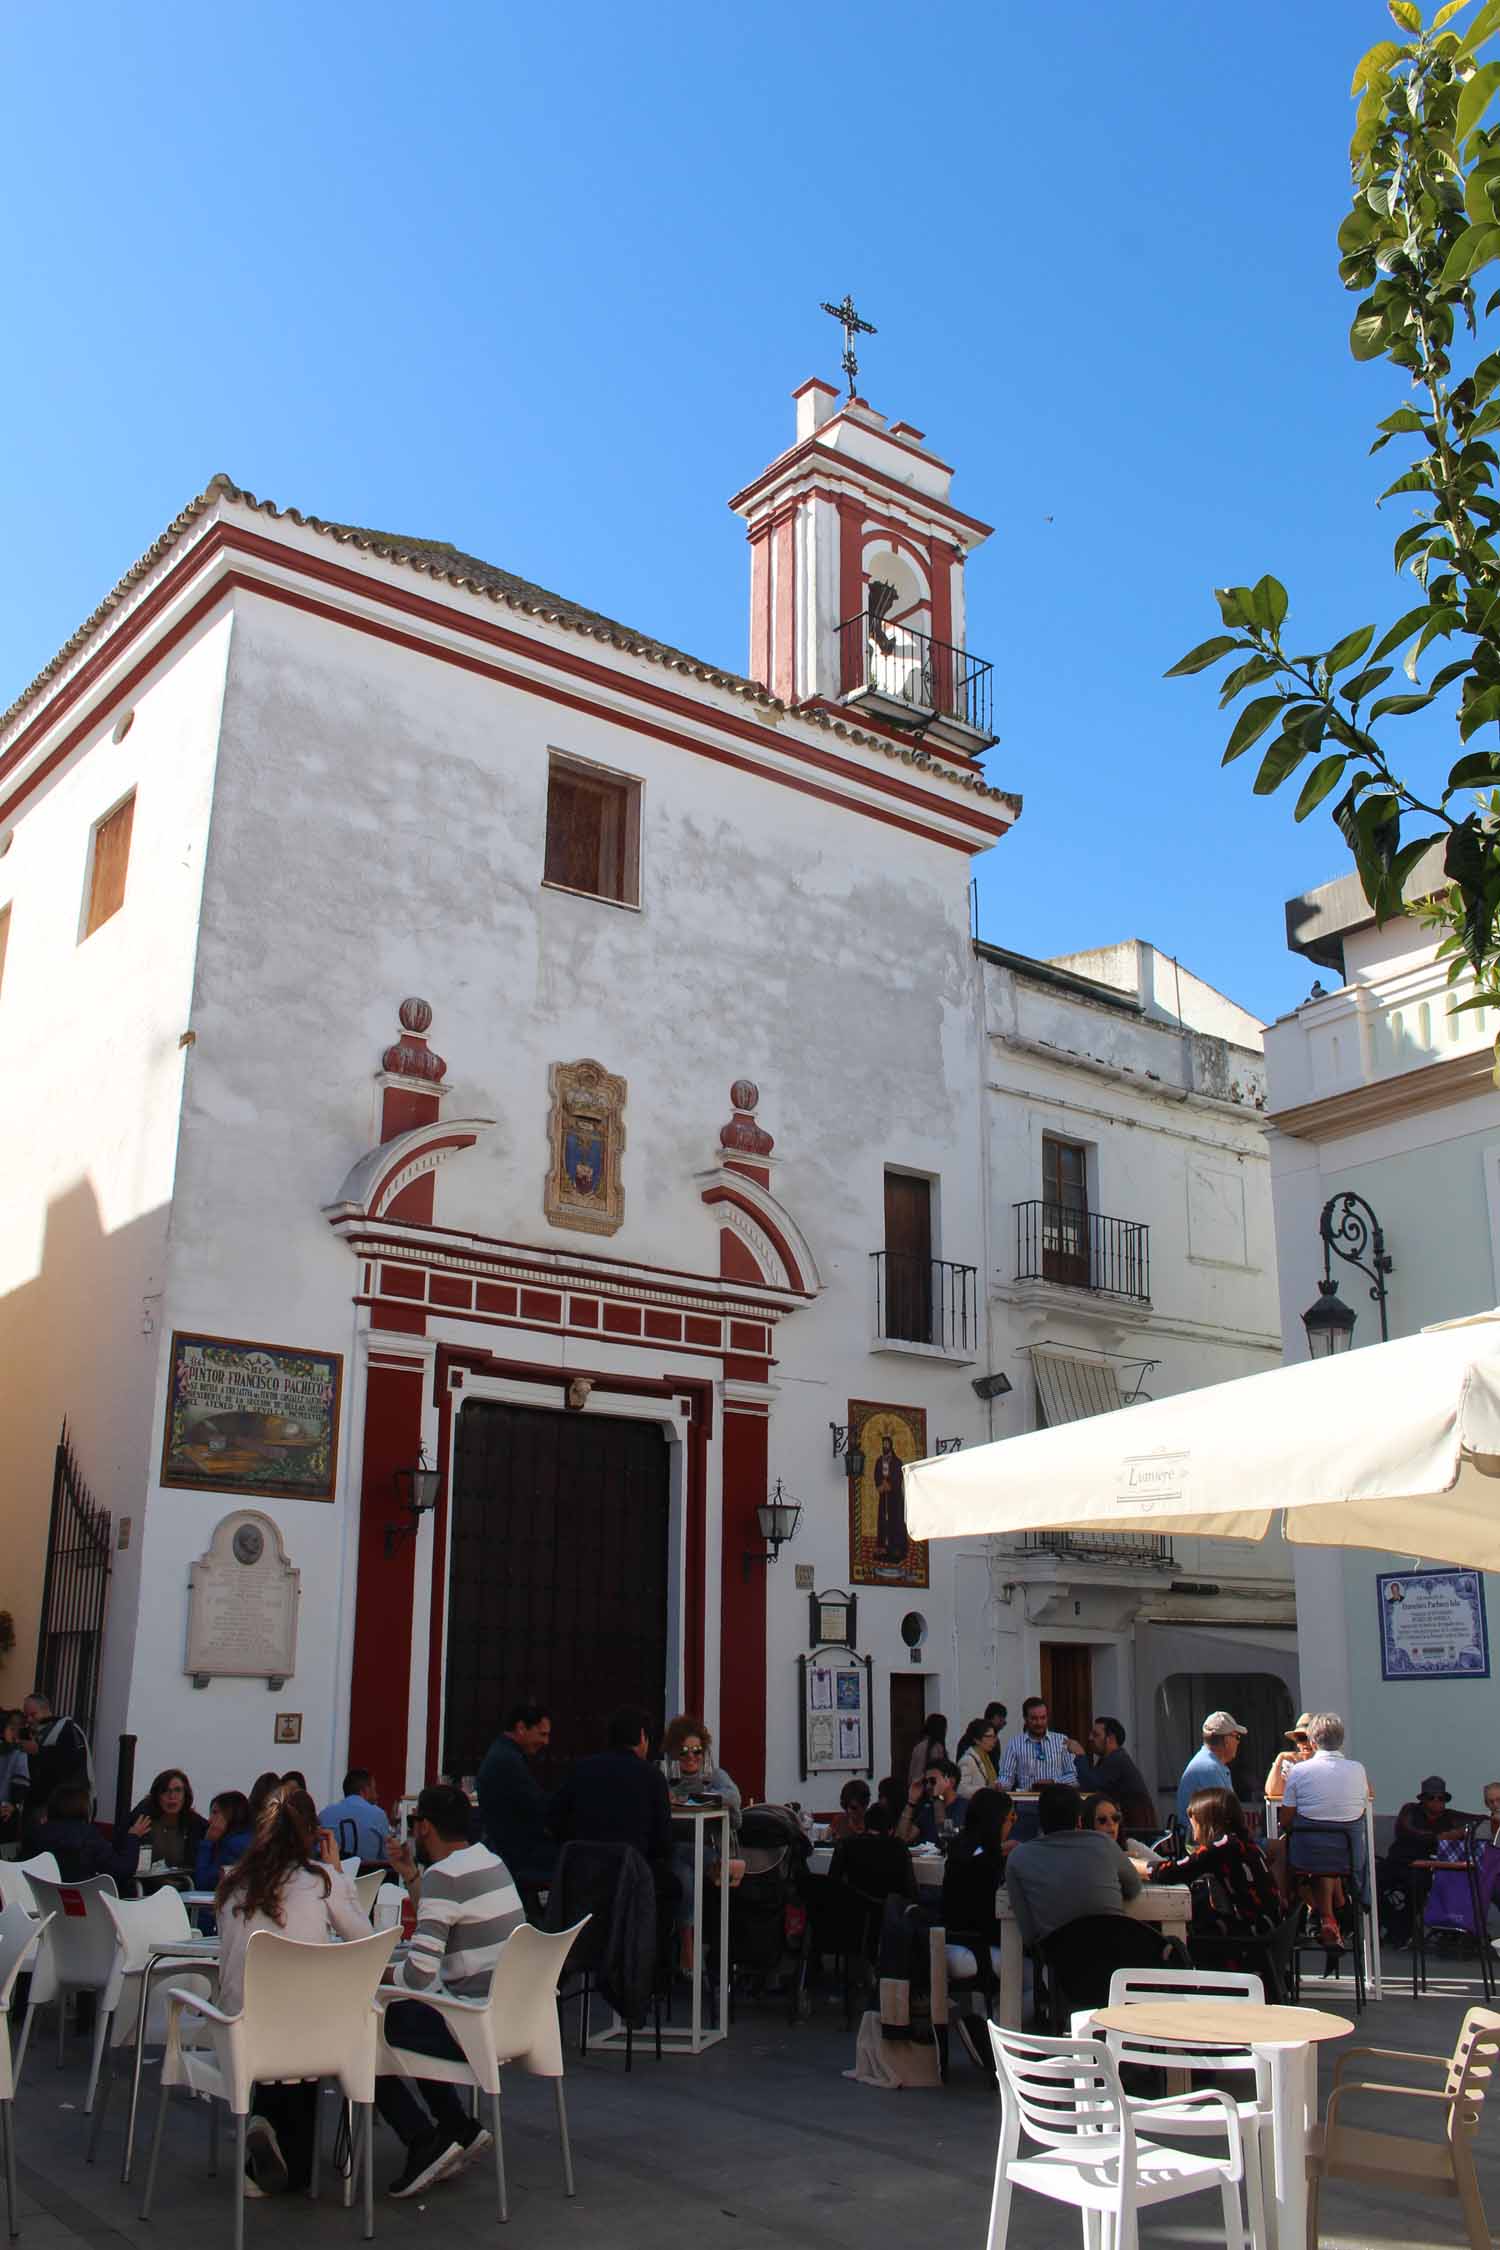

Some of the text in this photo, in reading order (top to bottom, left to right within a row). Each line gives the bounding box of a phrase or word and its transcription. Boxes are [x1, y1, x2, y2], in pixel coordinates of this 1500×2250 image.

[188, 1366, 324, 1396] PINTOR FRANCISCO PACHECO
